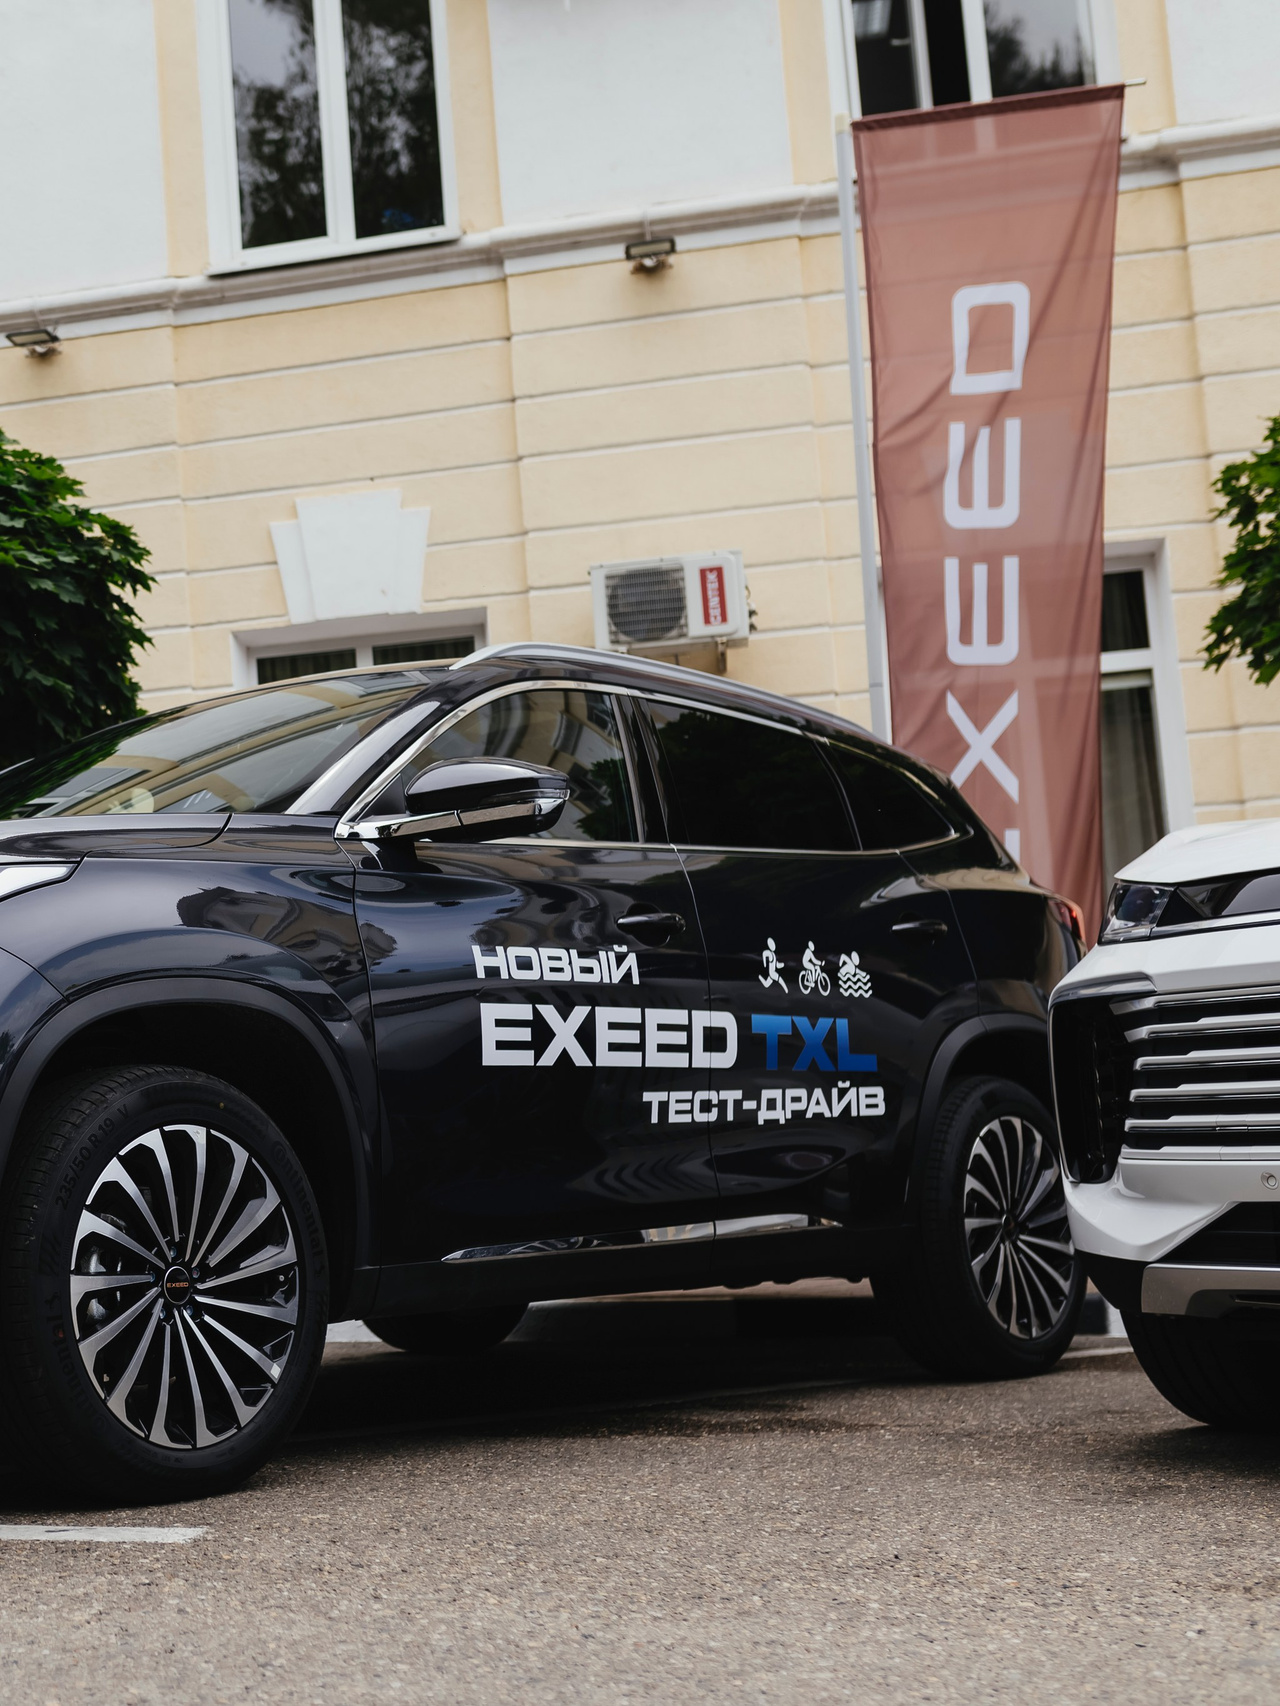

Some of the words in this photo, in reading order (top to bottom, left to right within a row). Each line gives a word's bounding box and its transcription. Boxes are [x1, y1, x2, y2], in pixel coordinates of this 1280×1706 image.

[943, 280, 1031, 866] XEED
[471, 944, 640, 985] НОВЫЙ
[480, 1002, 738, 1069] EXEED
[751, 1013, 878, 1072] TXL
[642, 1080, 886, 1125] ТЕСТ-ДРАЙВ
[166, 1281, 190, 1289] EXEED
